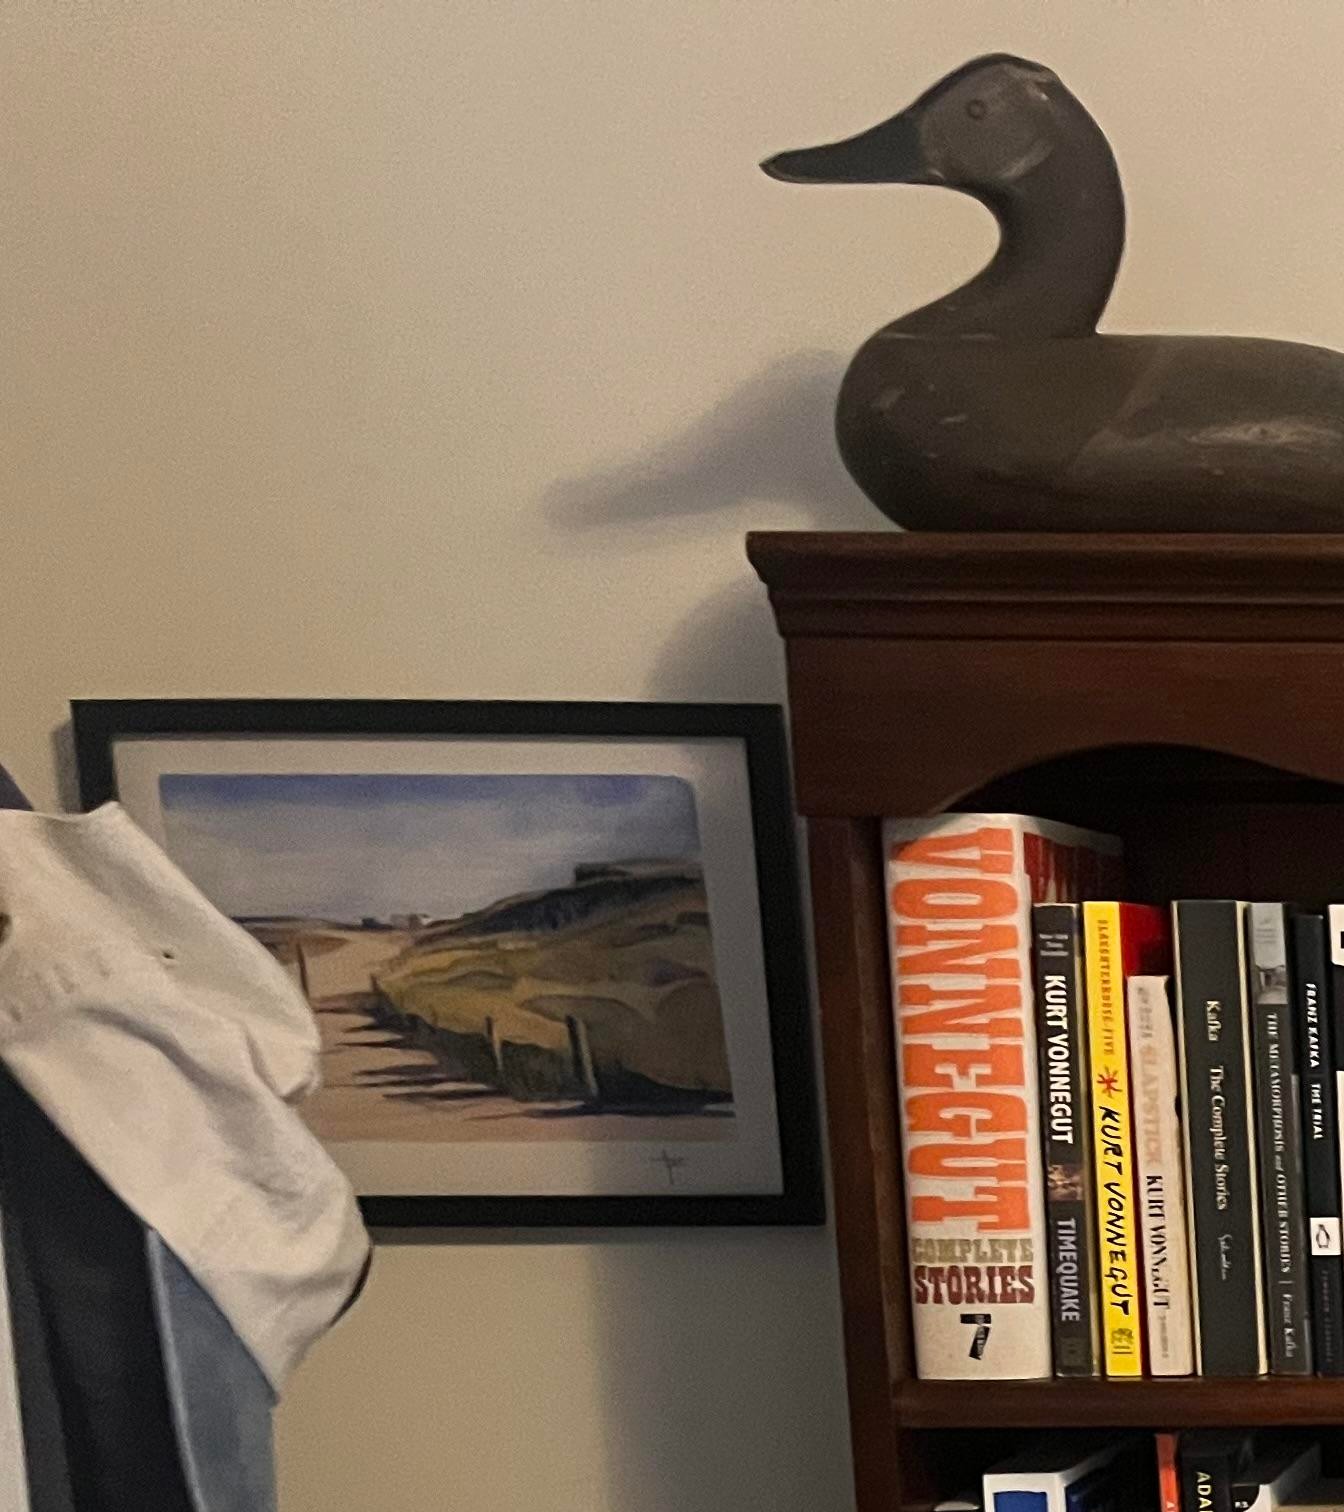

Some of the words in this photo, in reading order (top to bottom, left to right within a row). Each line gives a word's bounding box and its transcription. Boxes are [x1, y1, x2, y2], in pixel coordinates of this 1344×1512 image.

[890, 826, 1031, 1233] VONNEGUT
[1044, 975, 1067, 1028] KURT
[1047, 1031, 1073, 1144] VONNEGUT
[1099, 1106, 1124, 1175] KURT
[911, 1237, 1034, 1266] COMPLETE
[914, 1265, 1035, 1304] STORIES
[1056, 1217, 1081, 1322] TIMEQUAKE
[1103, 1182, 1134, 1316] VONNEGUT
